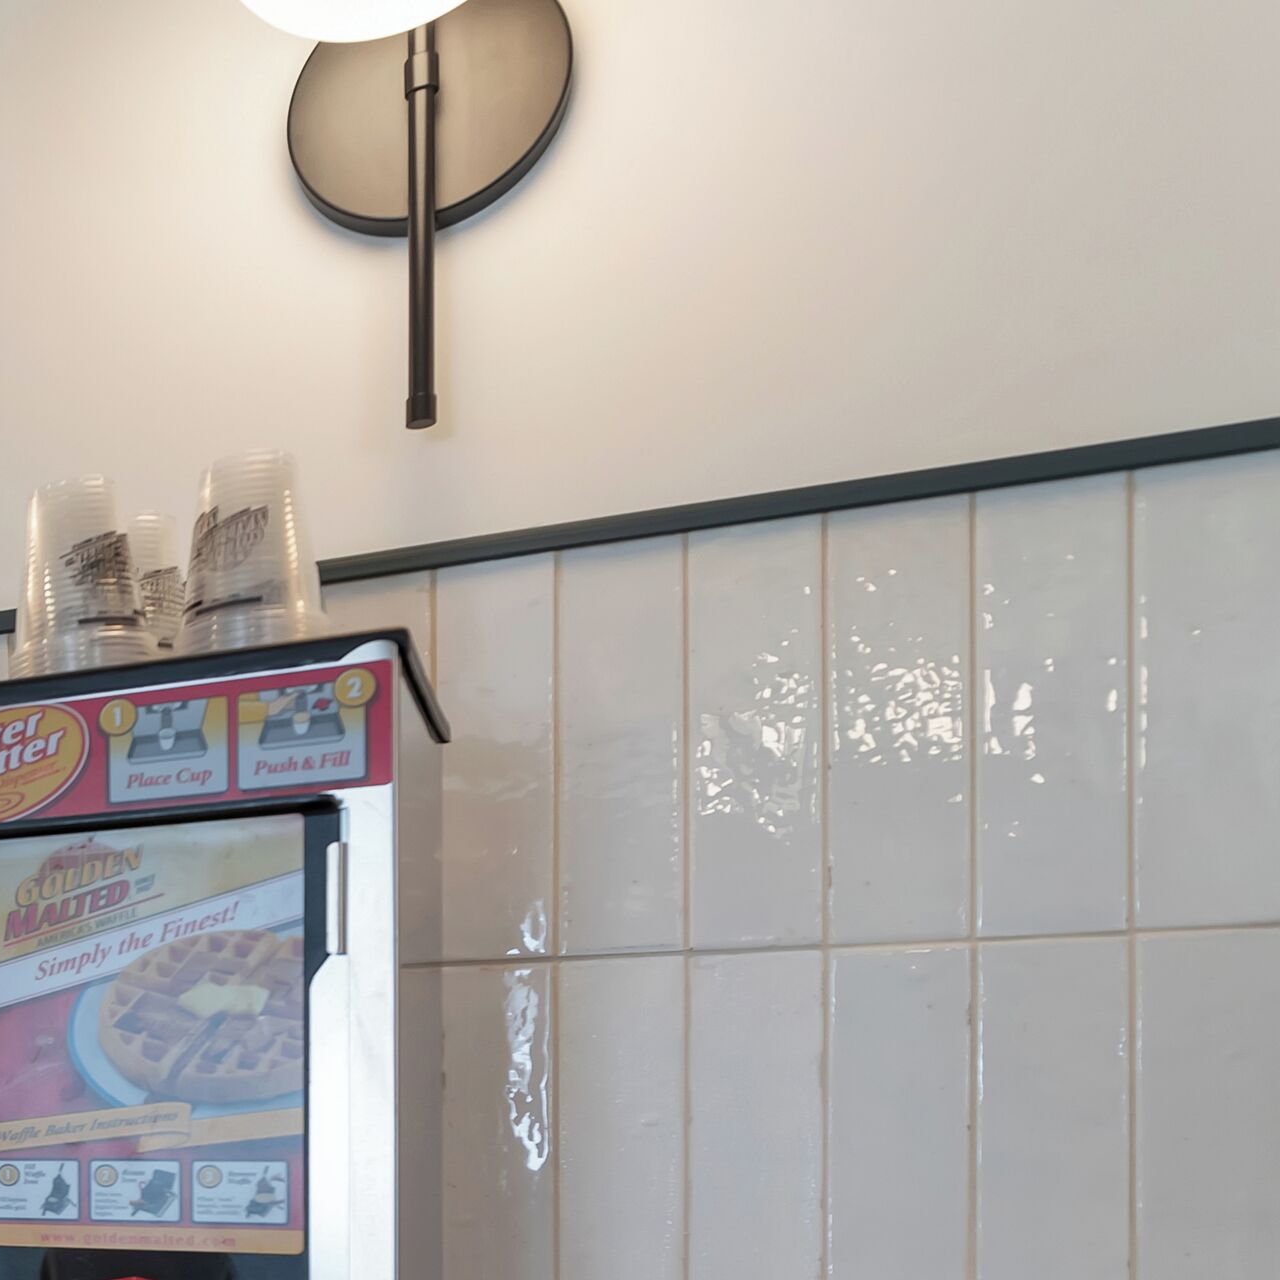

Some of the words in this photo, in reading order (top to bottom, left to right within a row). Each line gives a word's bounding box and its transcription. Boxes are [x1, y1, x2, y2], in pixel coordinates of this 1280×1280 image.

[346, 676, 363, 700] 2
[113, 707, 123, 727] 1
[253, 754, 299, 775] Push
[301, 753, 316, 770] &
[319, 750, 352, 769] Fill
[126, 771, 172, 789] Place
[175, 766, 213, 787] Cup
[15, 844, 144, 907] GOLDEN
[3, 879, 131, 943] MALTED
[34, 942, 112, 981] Simply
[118, 931, 154, 957] the
[159, 900, 240, 944] Finest!
[45, 1121, 86, 1137] Baker
[89, 1111, 180, 1132] Instructions
